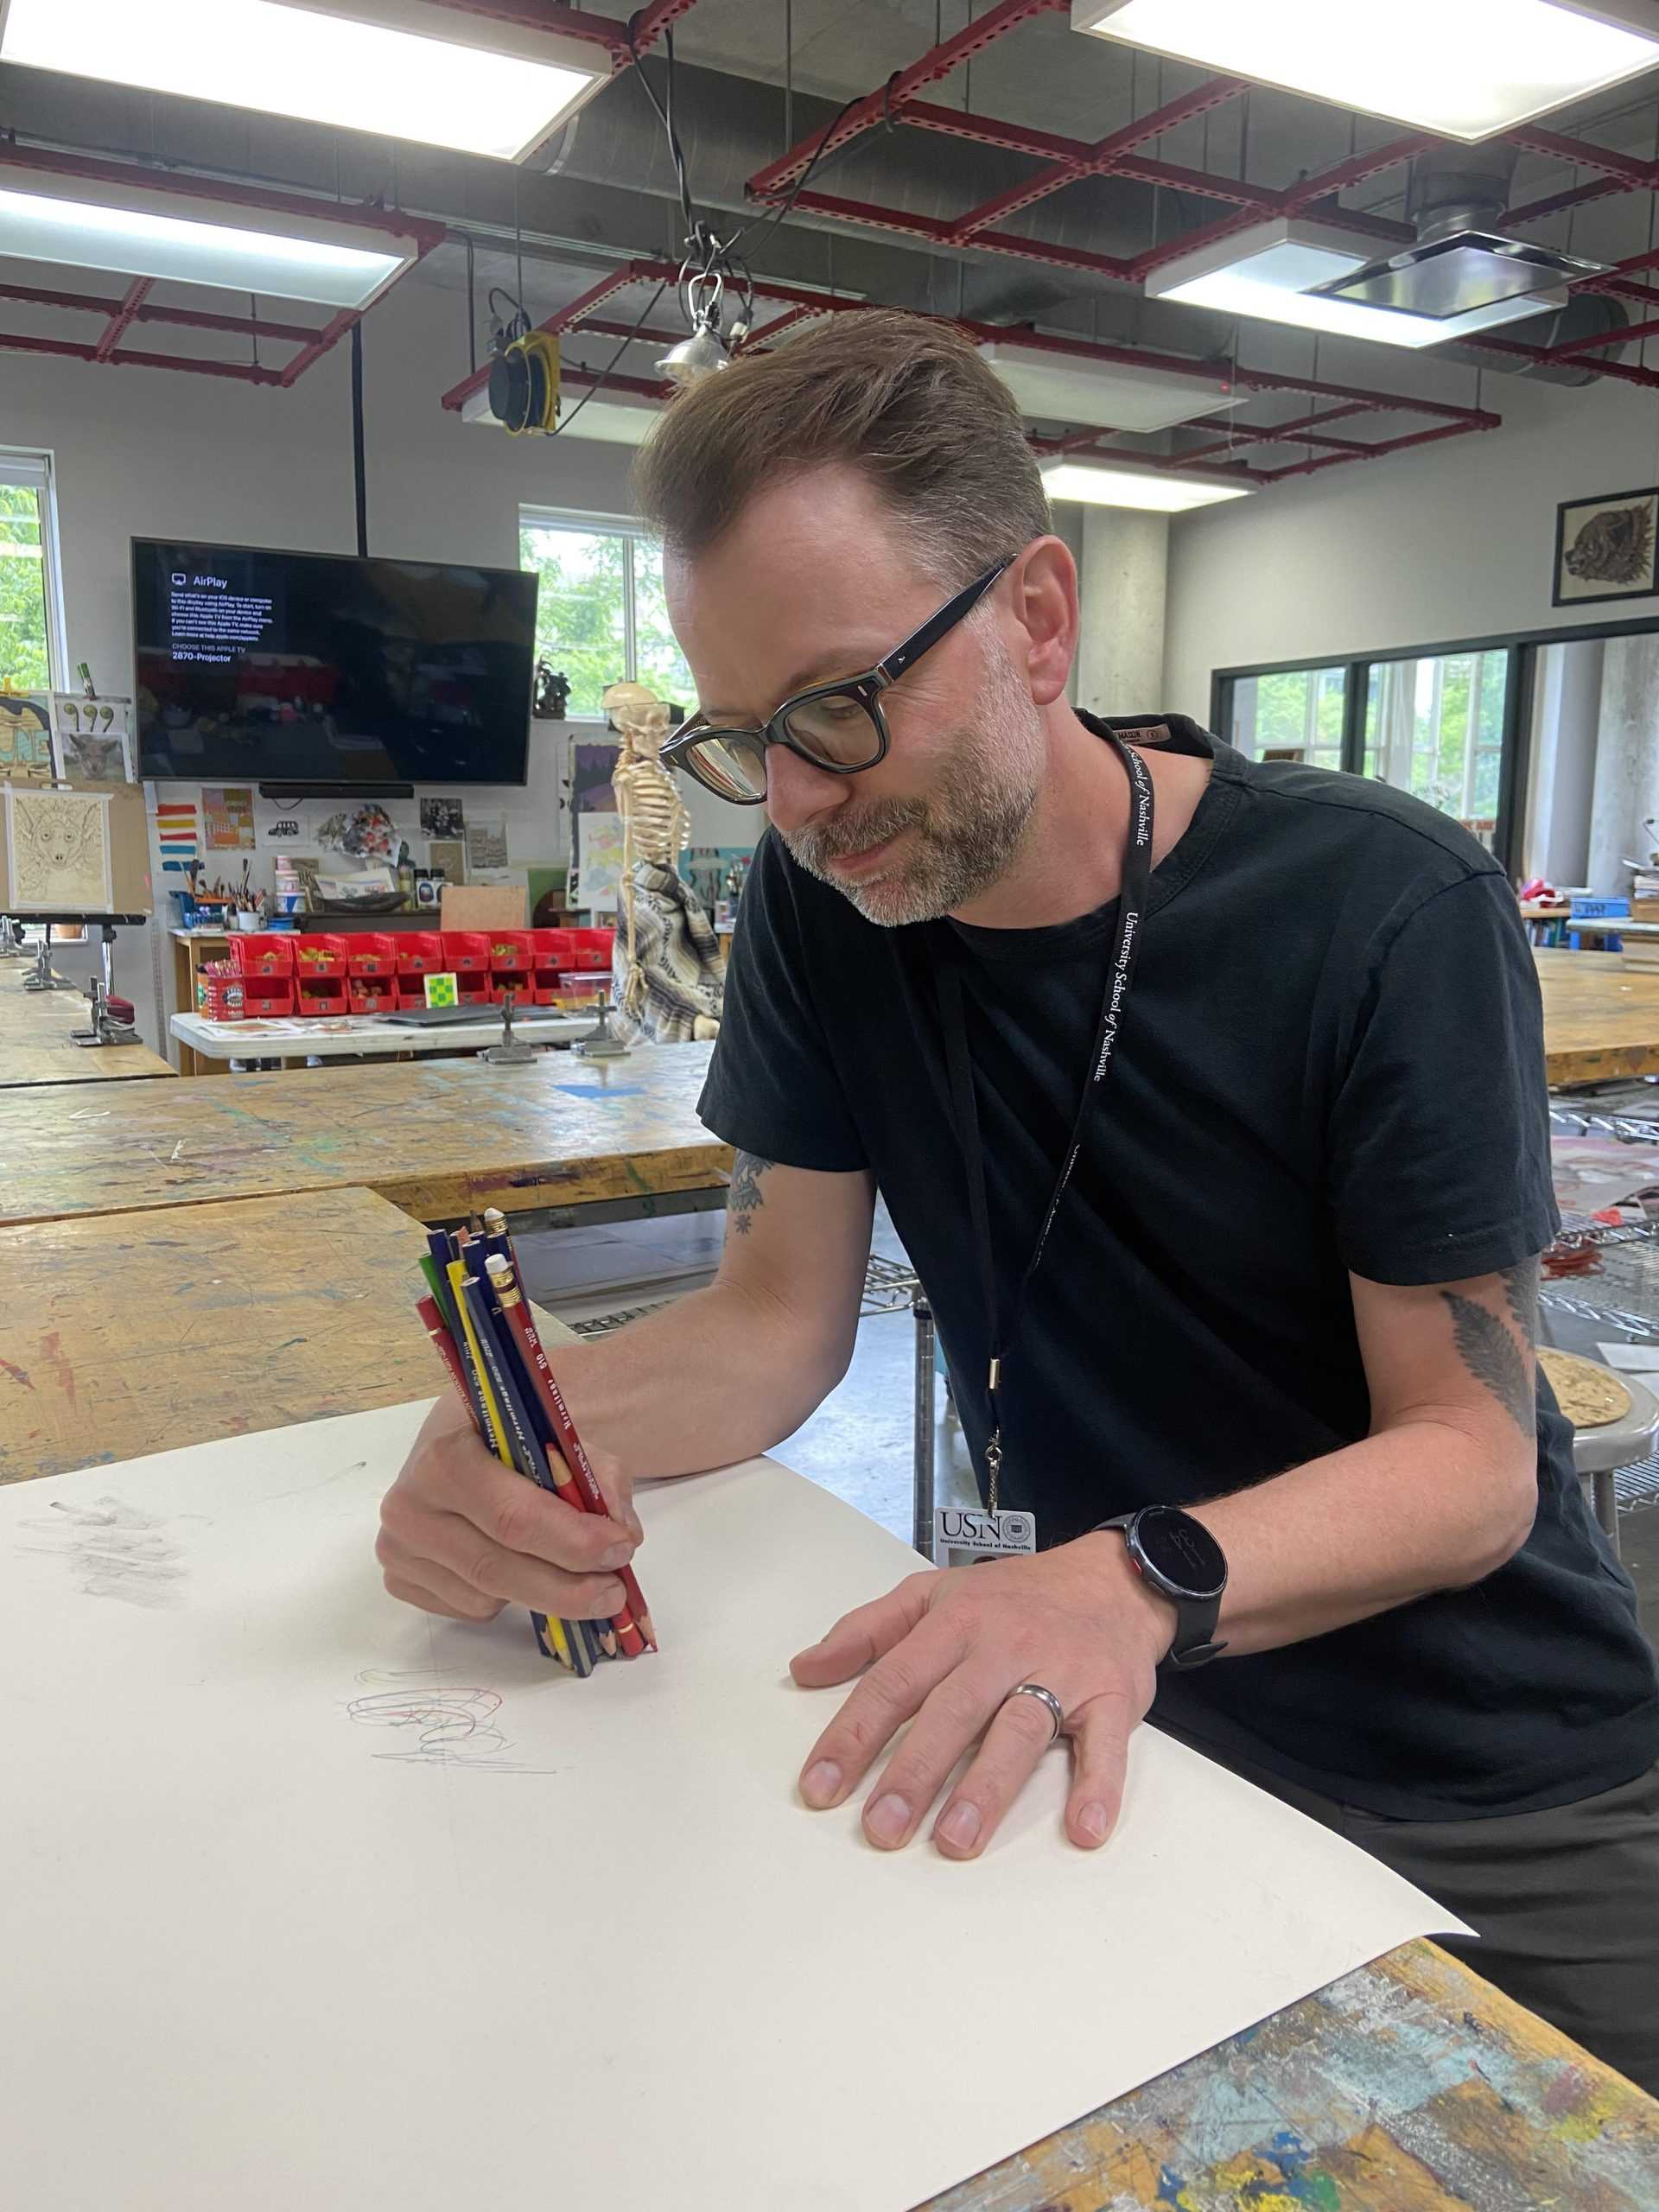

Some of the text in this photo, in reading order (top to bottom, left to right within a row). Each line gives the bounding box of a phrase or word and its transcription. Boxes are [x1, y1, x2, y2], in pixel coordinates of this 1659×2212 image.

[194, 575, 227, 589] AirPlay
[173, 651, 231, 663] 2870-Projector
[1128, 750, 1147, 779] School
[1135, 779, 1151, 795] of
[1136, 794, 1151, 846] Nashville
[1094, 912, 1138, 1082] University School of Nashville
[537, 1353, 548, 1369] 510
[478, 1389, 499, 1448] Hermitage
[500, 1386, 524, 1440] Hermitage
[940, 1511, 1002, 1540] USN
[940, 1538, 970, 1547] University
